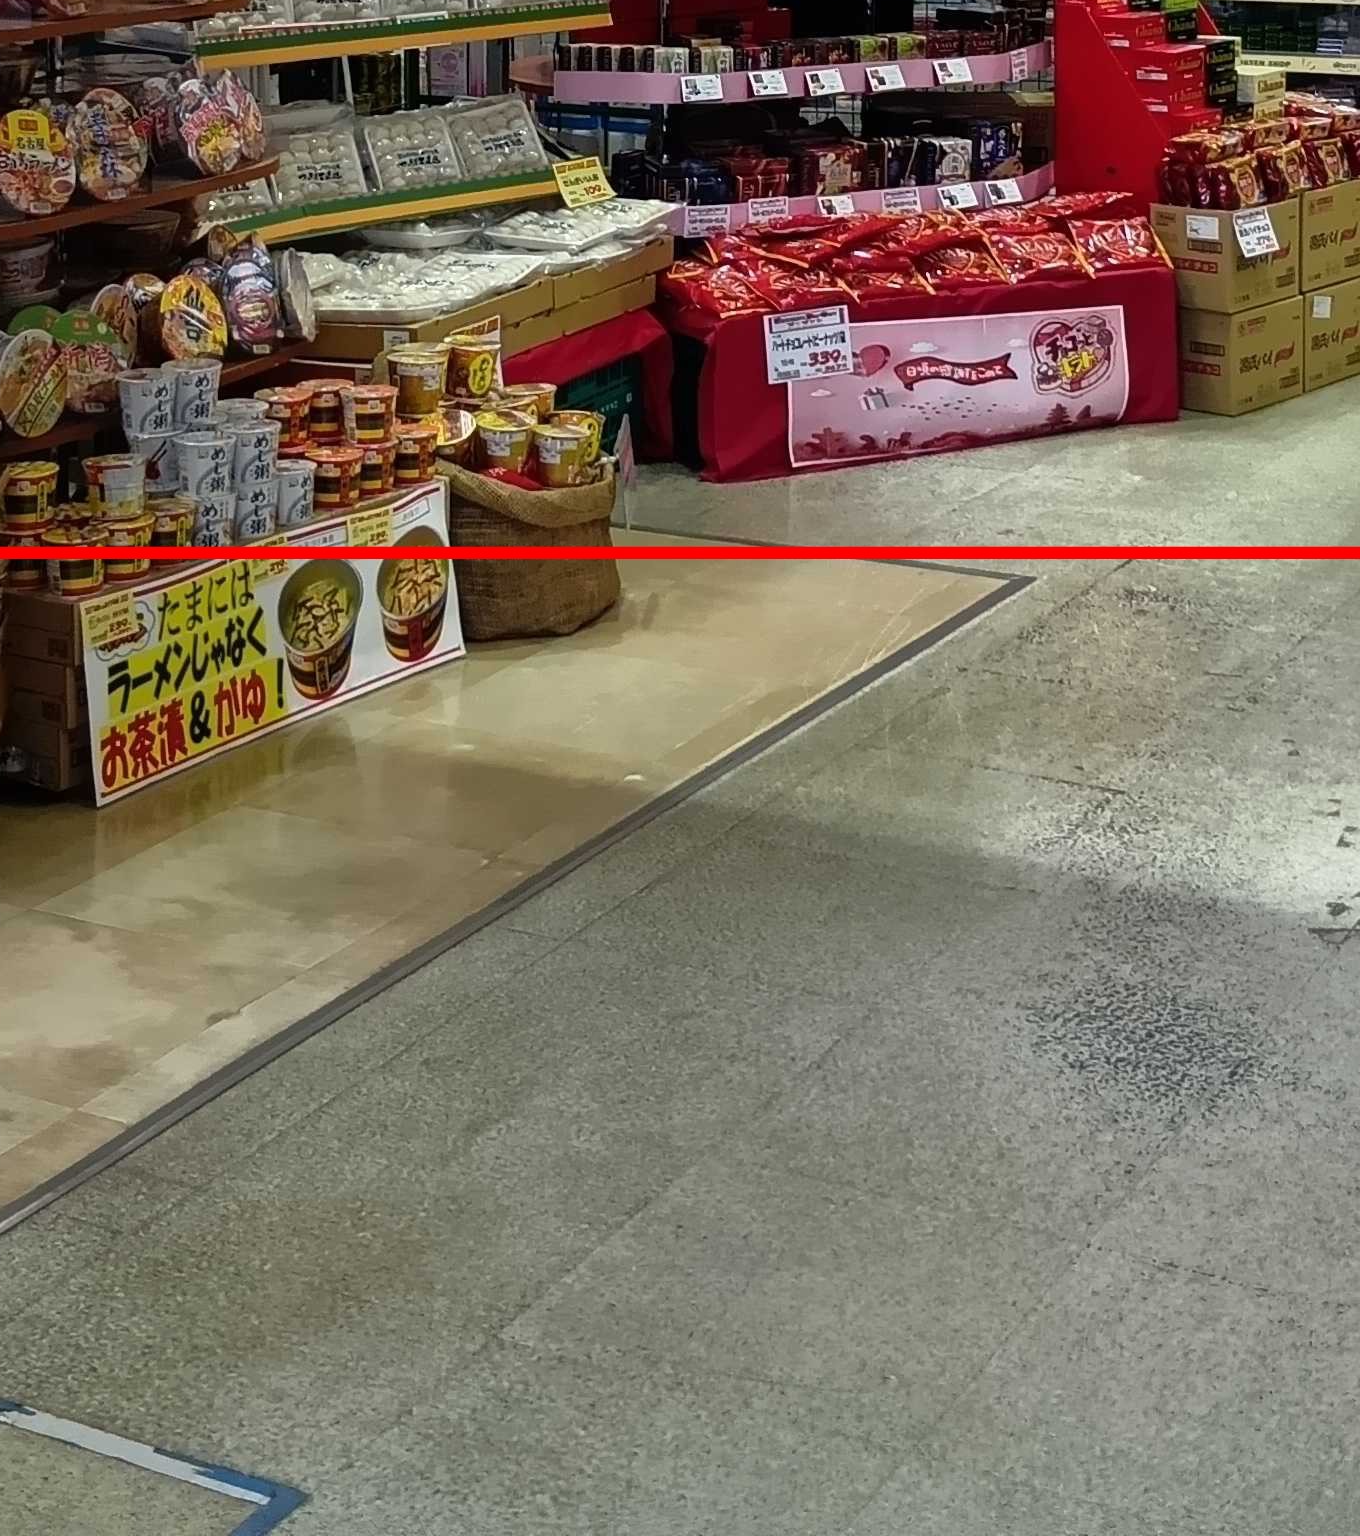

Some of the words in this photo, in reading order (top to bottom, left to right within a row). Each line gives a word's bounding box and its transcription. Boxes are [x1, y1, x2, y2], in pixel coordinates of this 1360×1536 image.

[157, 559, 256, 643] たまには
[108, 605, 267, 714] ラーメンじゃなく
